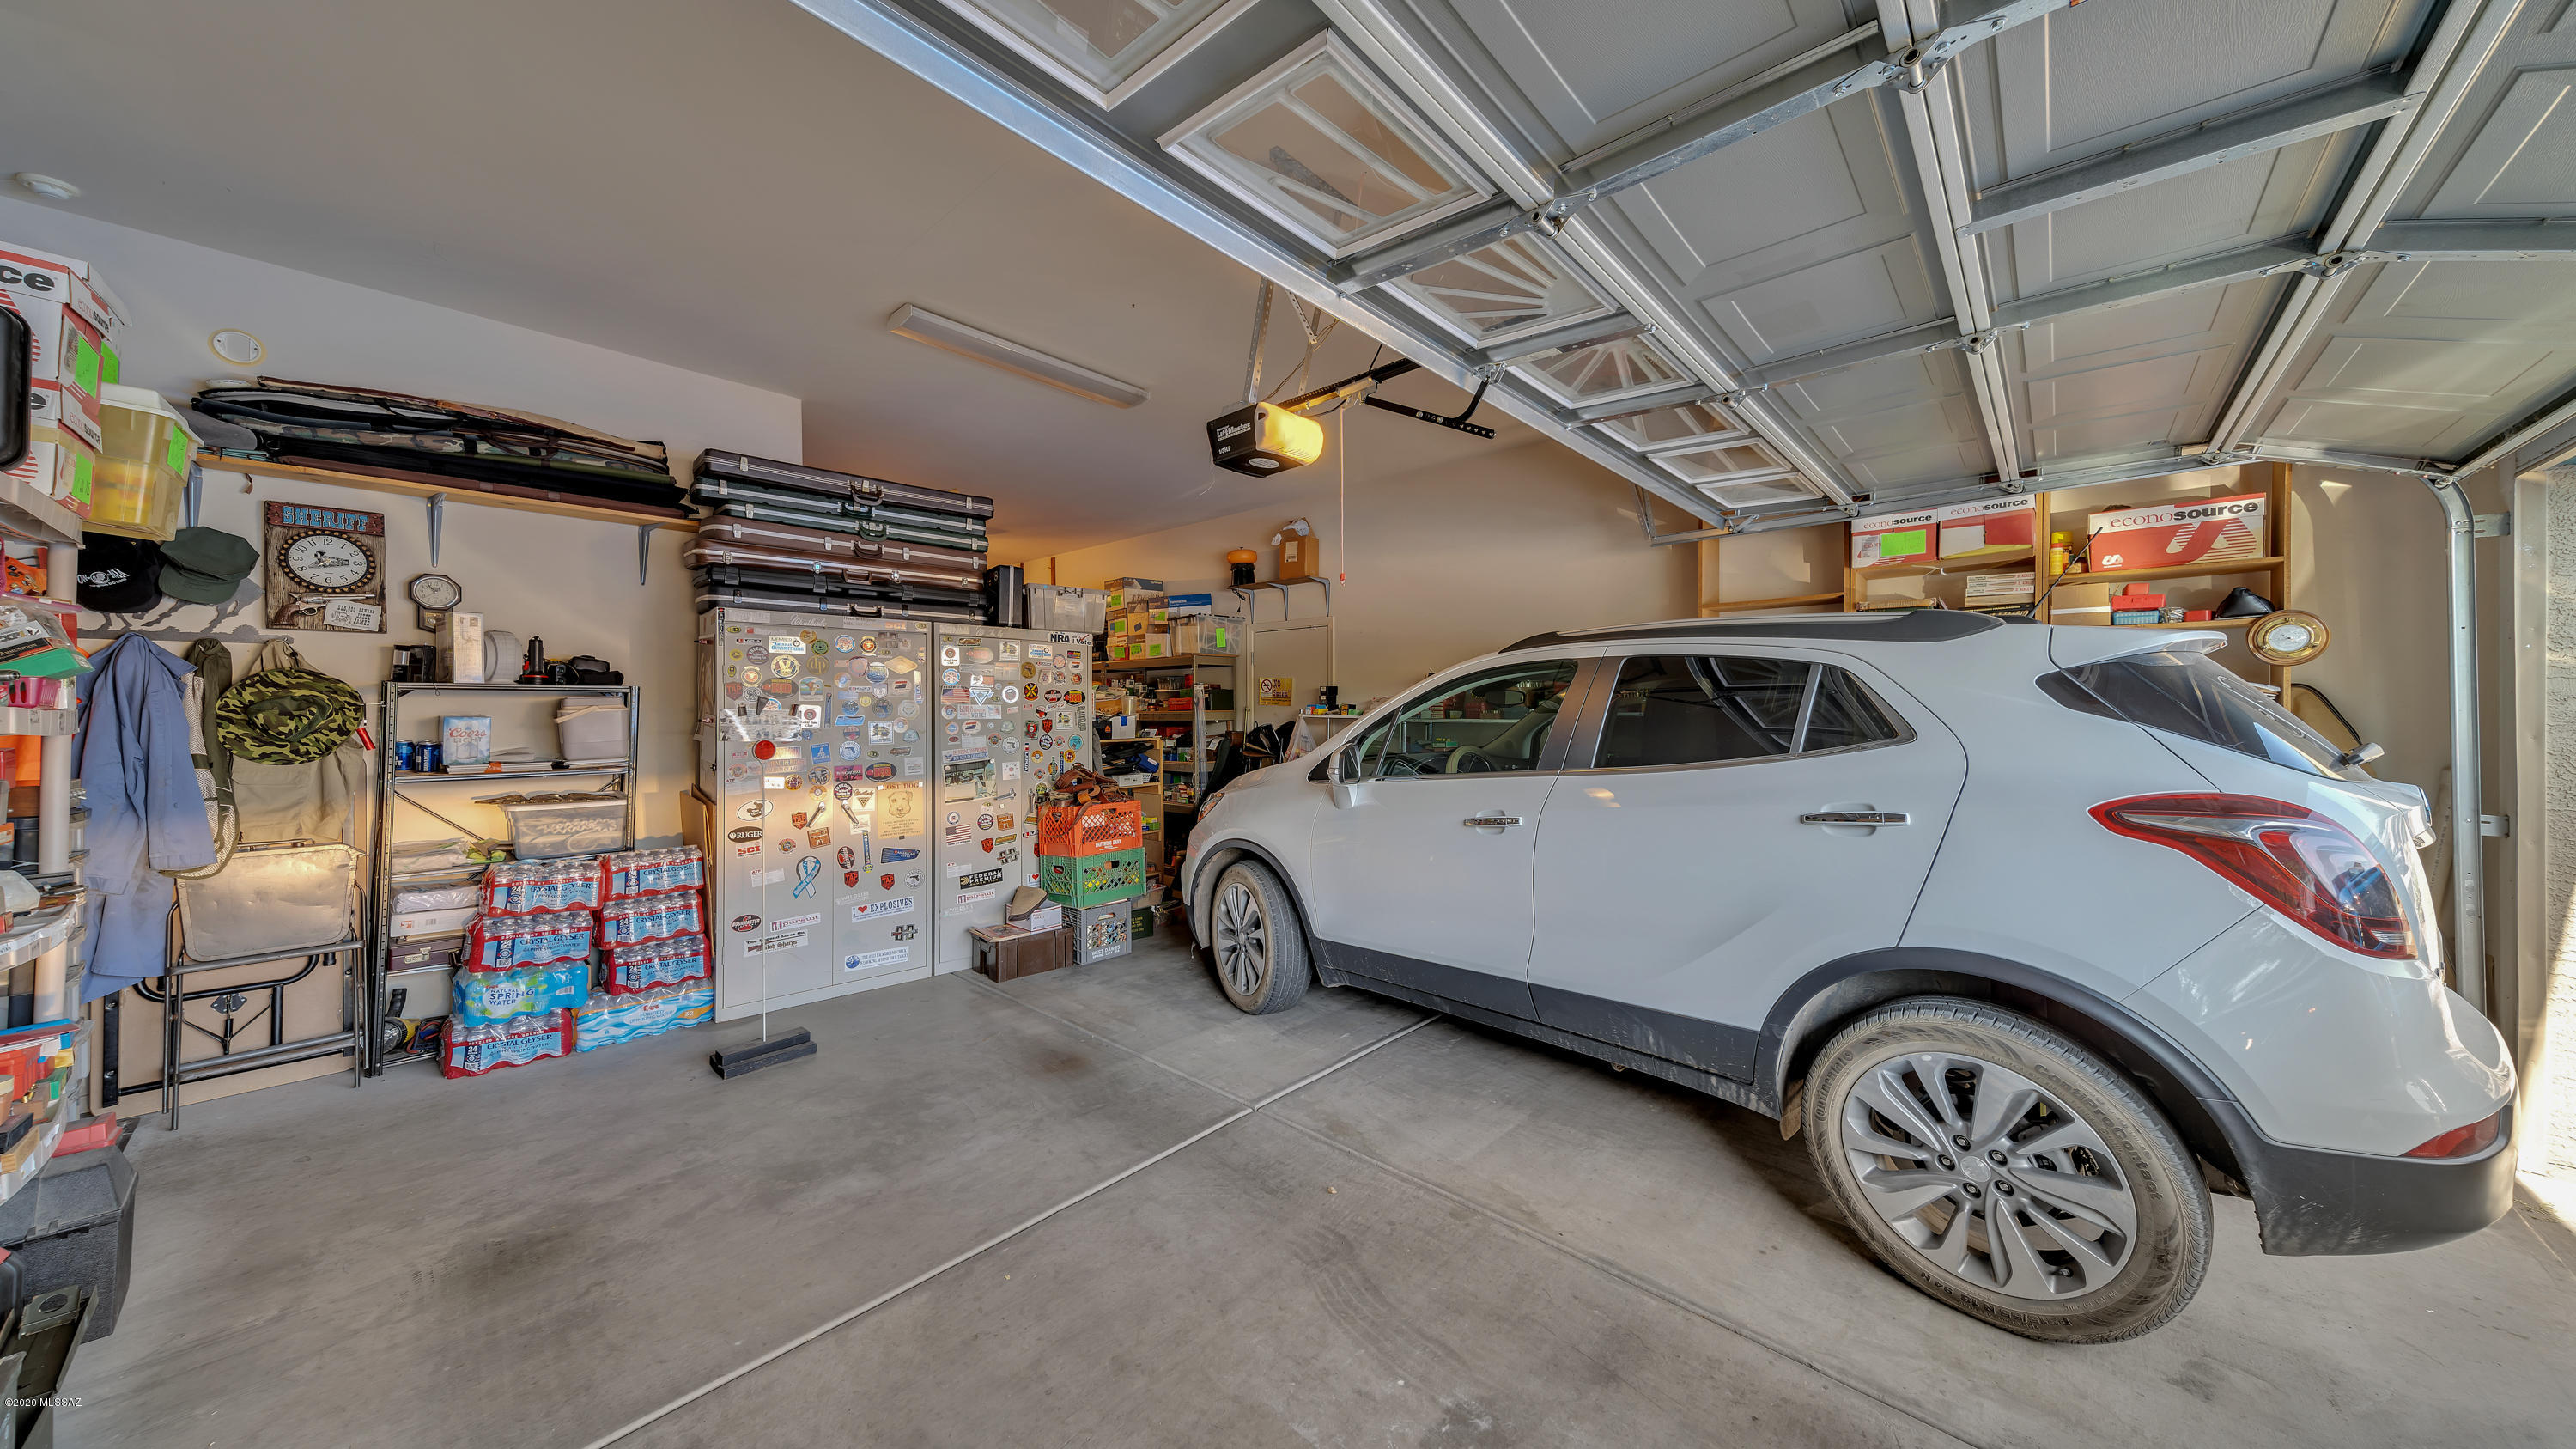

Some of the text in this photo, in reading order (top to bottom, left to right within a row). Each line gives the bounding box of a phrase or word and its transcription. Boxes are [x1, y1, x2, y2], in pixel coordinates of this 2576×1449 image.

[1951, 498, 2028, 515] econosource
[282, 506, 369, 532] SHERIFF
[2111, 502, 2258, 528] econosource
[1863, 514, 1932, 529] econosource
[323, 538, 333, 546] 12
[295, 545, 307, 554] 10
[339, 575, 349, 583] 5
[1050, 634, 1070, 642] NRA
[449, 727, 487, 738] Coors
[736, 830, 762, 838] RUGER
[738, 846, 761, 855] SCI
[969, 869, 1001, 880] FEDERAL
[969, 874, 1002, 884] PREMIUM
[870, 898, 913, 912] EXPLOSIVES
[636, 910, 690, 923] CRYSTAL GEYSER
[783, 915, 818, 927] pursuit
[519, 935, 551, 946] CRYSTAL
[489, 988, 535, 1000] SPRING
[487, 1034, 552, 1050] CRYSTAL GEYSER
[1815, 1057, 1848, 1121] Continental
